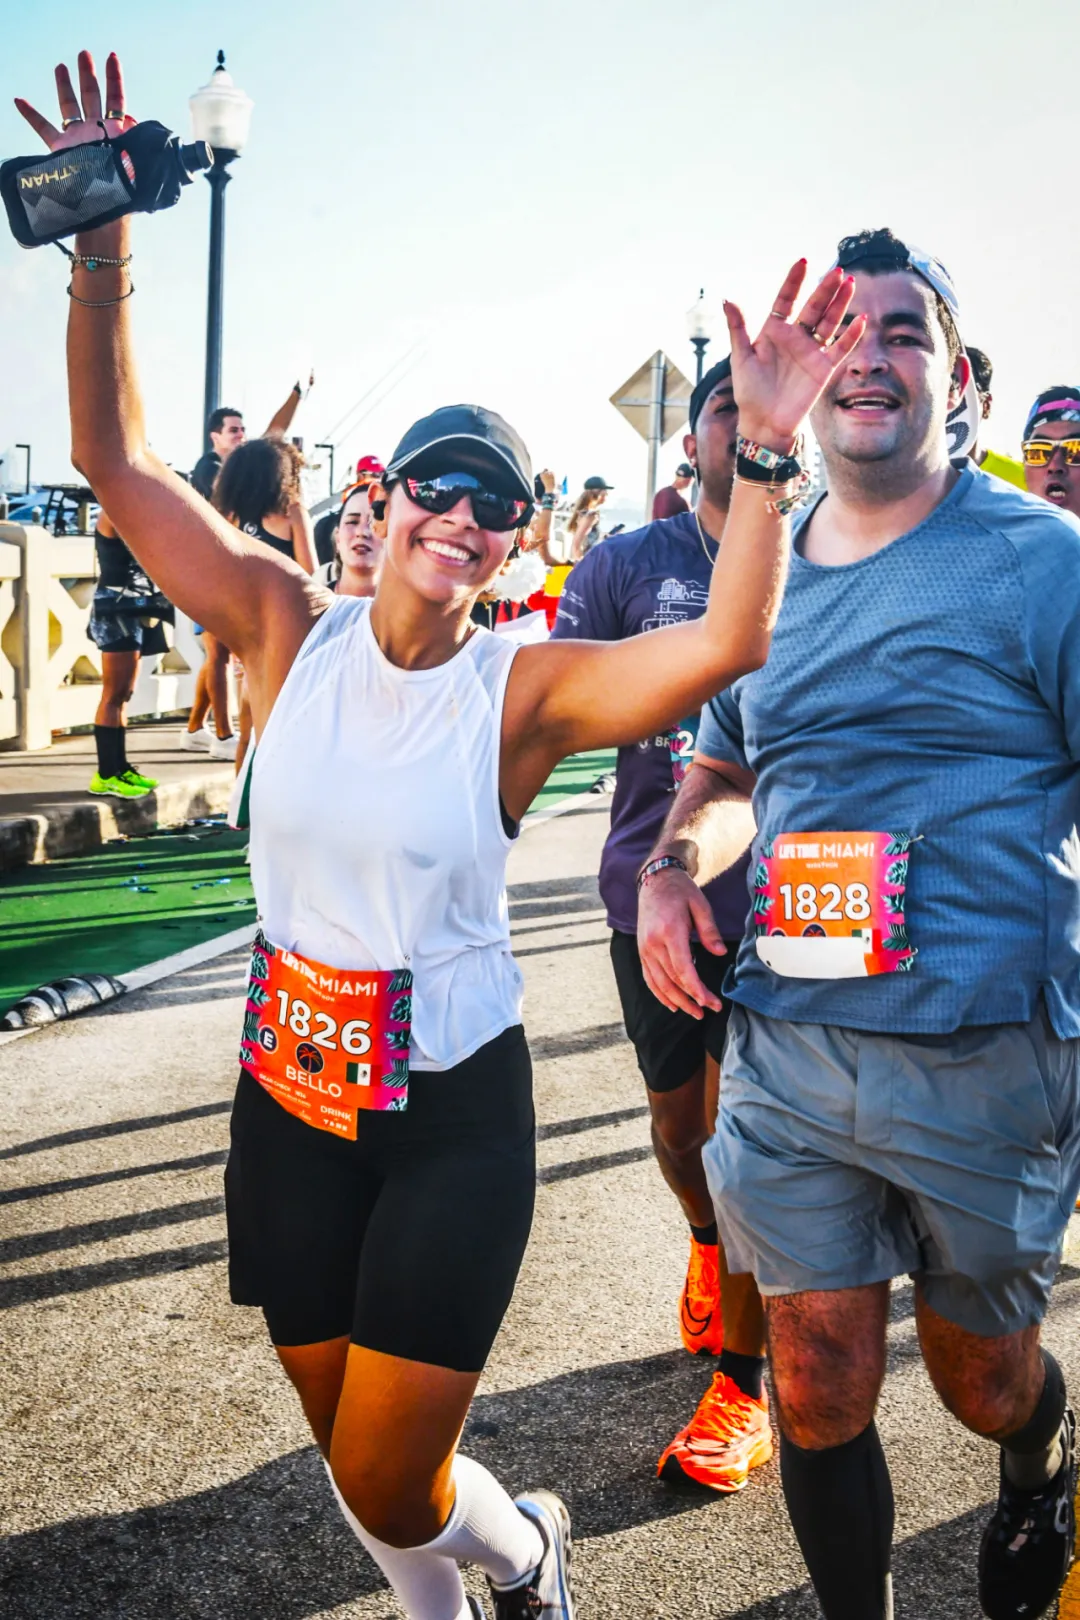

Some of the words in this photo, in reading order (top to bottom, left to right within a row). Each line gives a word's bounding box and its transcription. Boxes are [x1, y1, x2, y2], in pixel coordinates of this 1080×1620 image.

[676, 730, 694, 757] 2
[823, 842, 875, 858] MIAMI
[779, 881, 871, 921] 1828
[319, 975, 378, 997] MIAMI
[276, 988, 372, 1055] 1826
[263, 1031, 274, 1048] E
[285, 1064, 342, 1098] BELLO
[320, 1105, 352, 1122] DRINK
